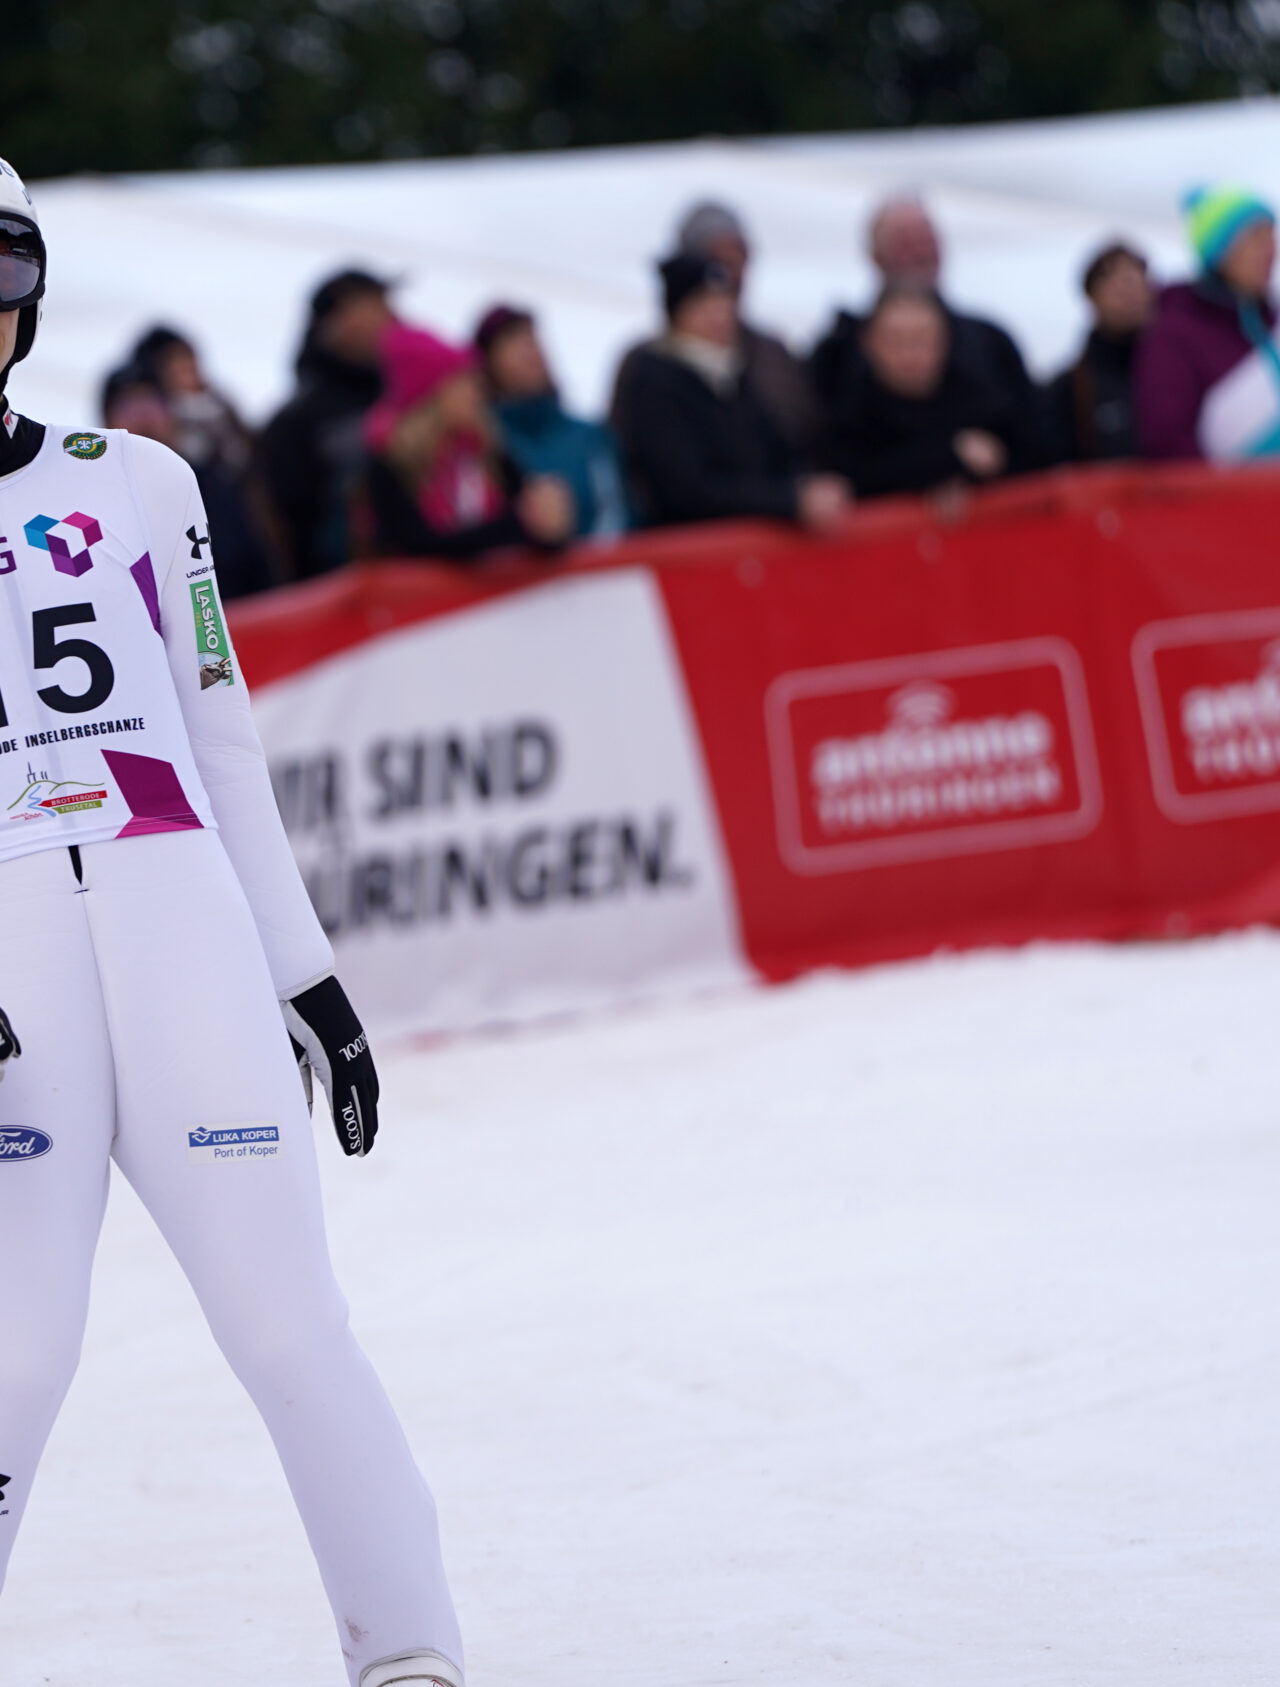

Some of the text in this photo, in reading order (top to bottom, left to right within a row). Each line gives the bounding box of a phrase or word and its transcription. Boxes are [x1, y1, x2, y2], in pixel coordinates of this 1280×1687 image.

[25, 717, 146, 748] INSELBERGSCHANZE
[366, 716, 563, 825] SIND
[212, 1129, 277, 1143] LUKA KOPER
[214, 1145, 279, 1158] Port of Koper
